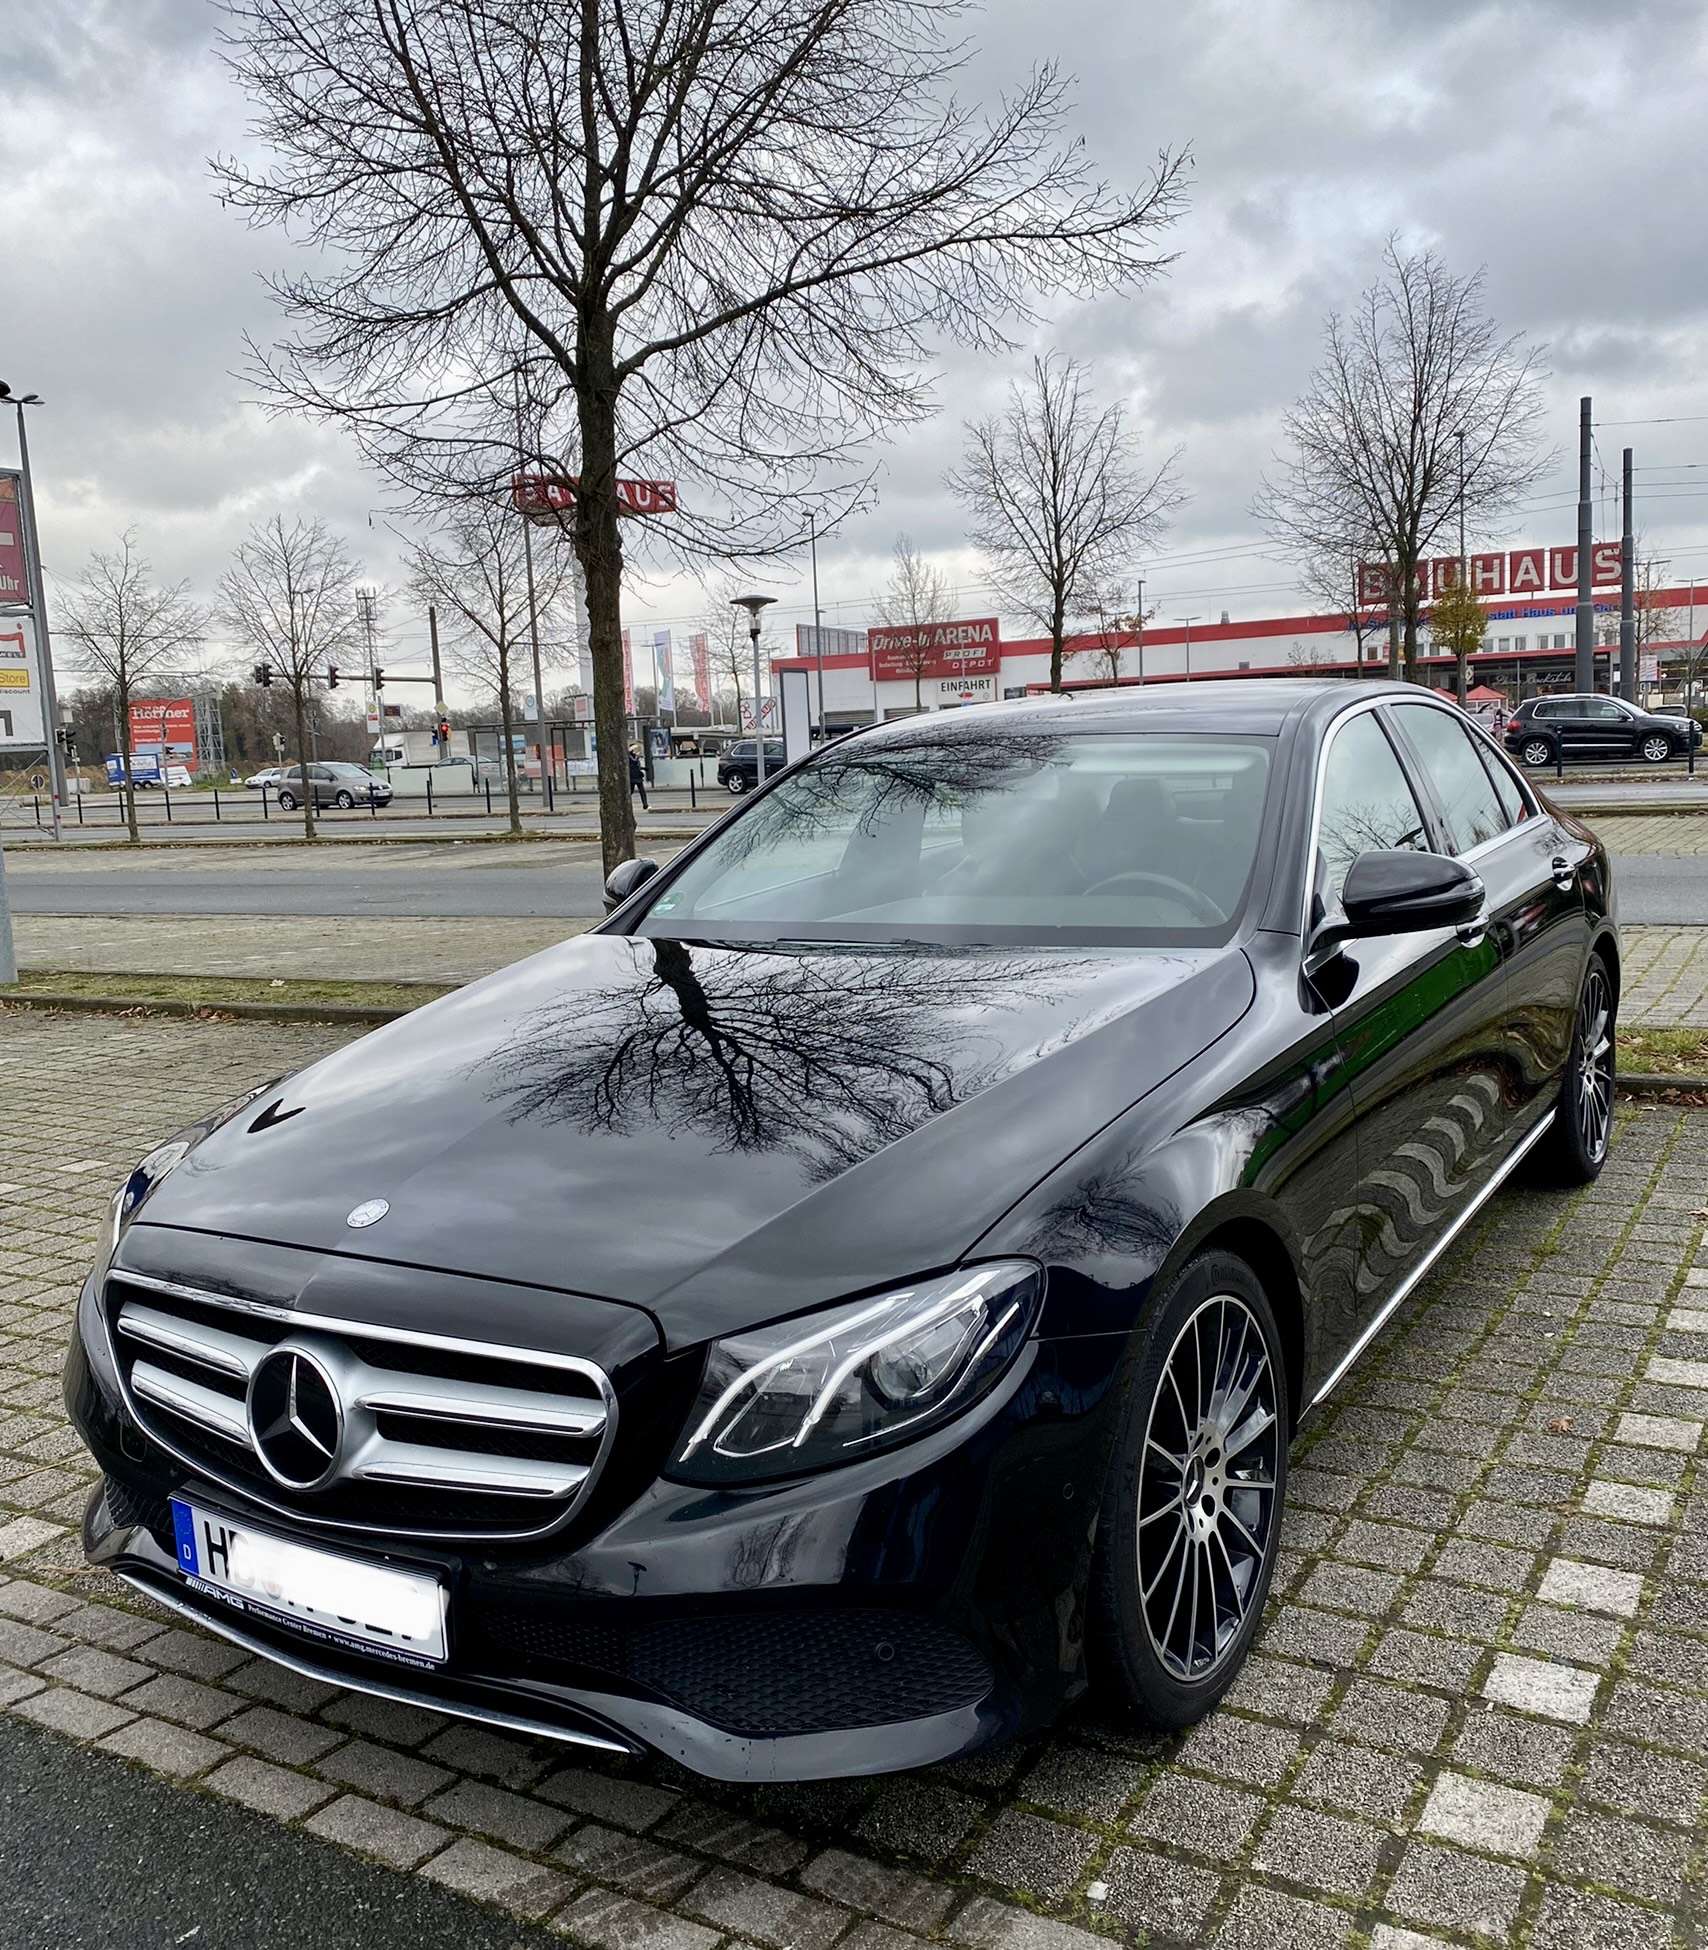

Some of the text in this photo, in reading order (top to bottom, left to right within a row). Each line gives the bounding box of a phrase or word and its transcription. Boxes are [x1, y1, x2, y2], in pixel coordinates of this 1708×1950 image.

[934, 623, 994, 646] ARENA
[944, 648, 986, 659] PROFI
[951, 659, 994, 669] DEPOT
[940, 679, 992, 693] EINFAHRT
[182, 1543, 192, 1561] D
[204, 1585, 245, 1610] AMG
[247, 1604, 282, 1623] Performance
[282, 1616, 302, 1631] Center
[302, 1624, 327, 1640] Bremen
